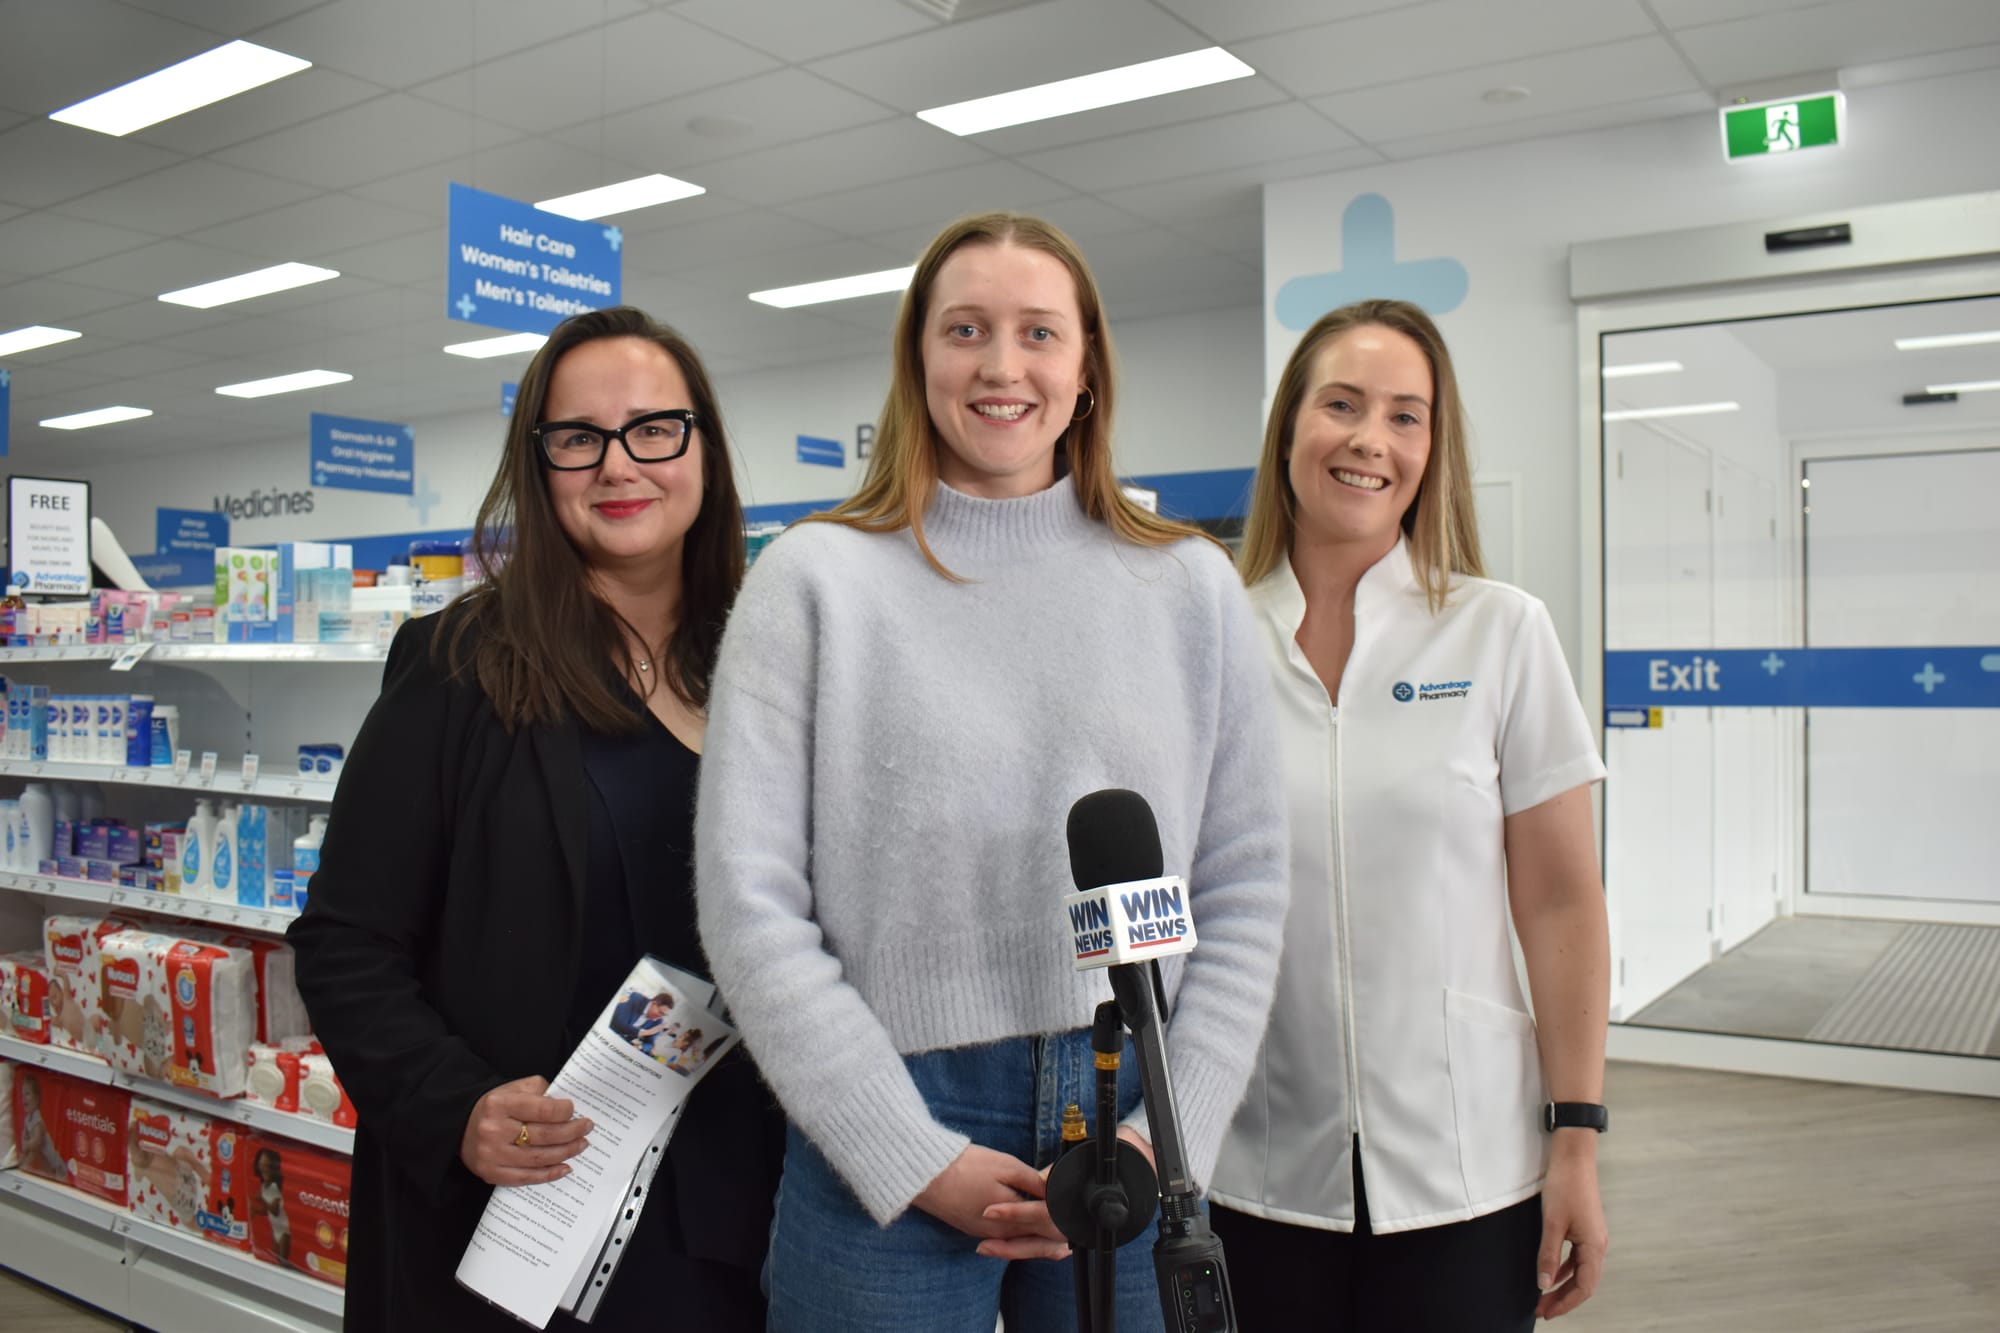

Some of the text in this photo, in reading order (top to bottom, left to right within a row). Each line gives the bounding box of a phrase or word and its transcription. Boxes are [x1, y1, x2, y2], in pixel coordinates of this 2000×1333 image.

[500, 223, 576, 259] Hair Care
[460, 243, 612, 296] Women's Toiletries
[475, 278, 525, 306] Men's
[30, 493, 72, 511] FREE
[213, 486, 315, 521] Medicines
[34, 581, 82, 593] Pharmacy
[35, 571, 87, 584] Advantage
[1418, 680, 1472, 693] Advantage
[1648, 656, 1721, 691] Exit
[1418, 689, 1469, 702] Pharmacy
[1068, 896, 1110, 934] WIN
[1120, 886, 1184, 923] WIN
[1074, 929, 1114, 954] NEWS
[1127, 917, 1188, 944] NEWS
[66, 1107, 117, 1135] essentials
[298, 1190, 350, 1218] essenti
